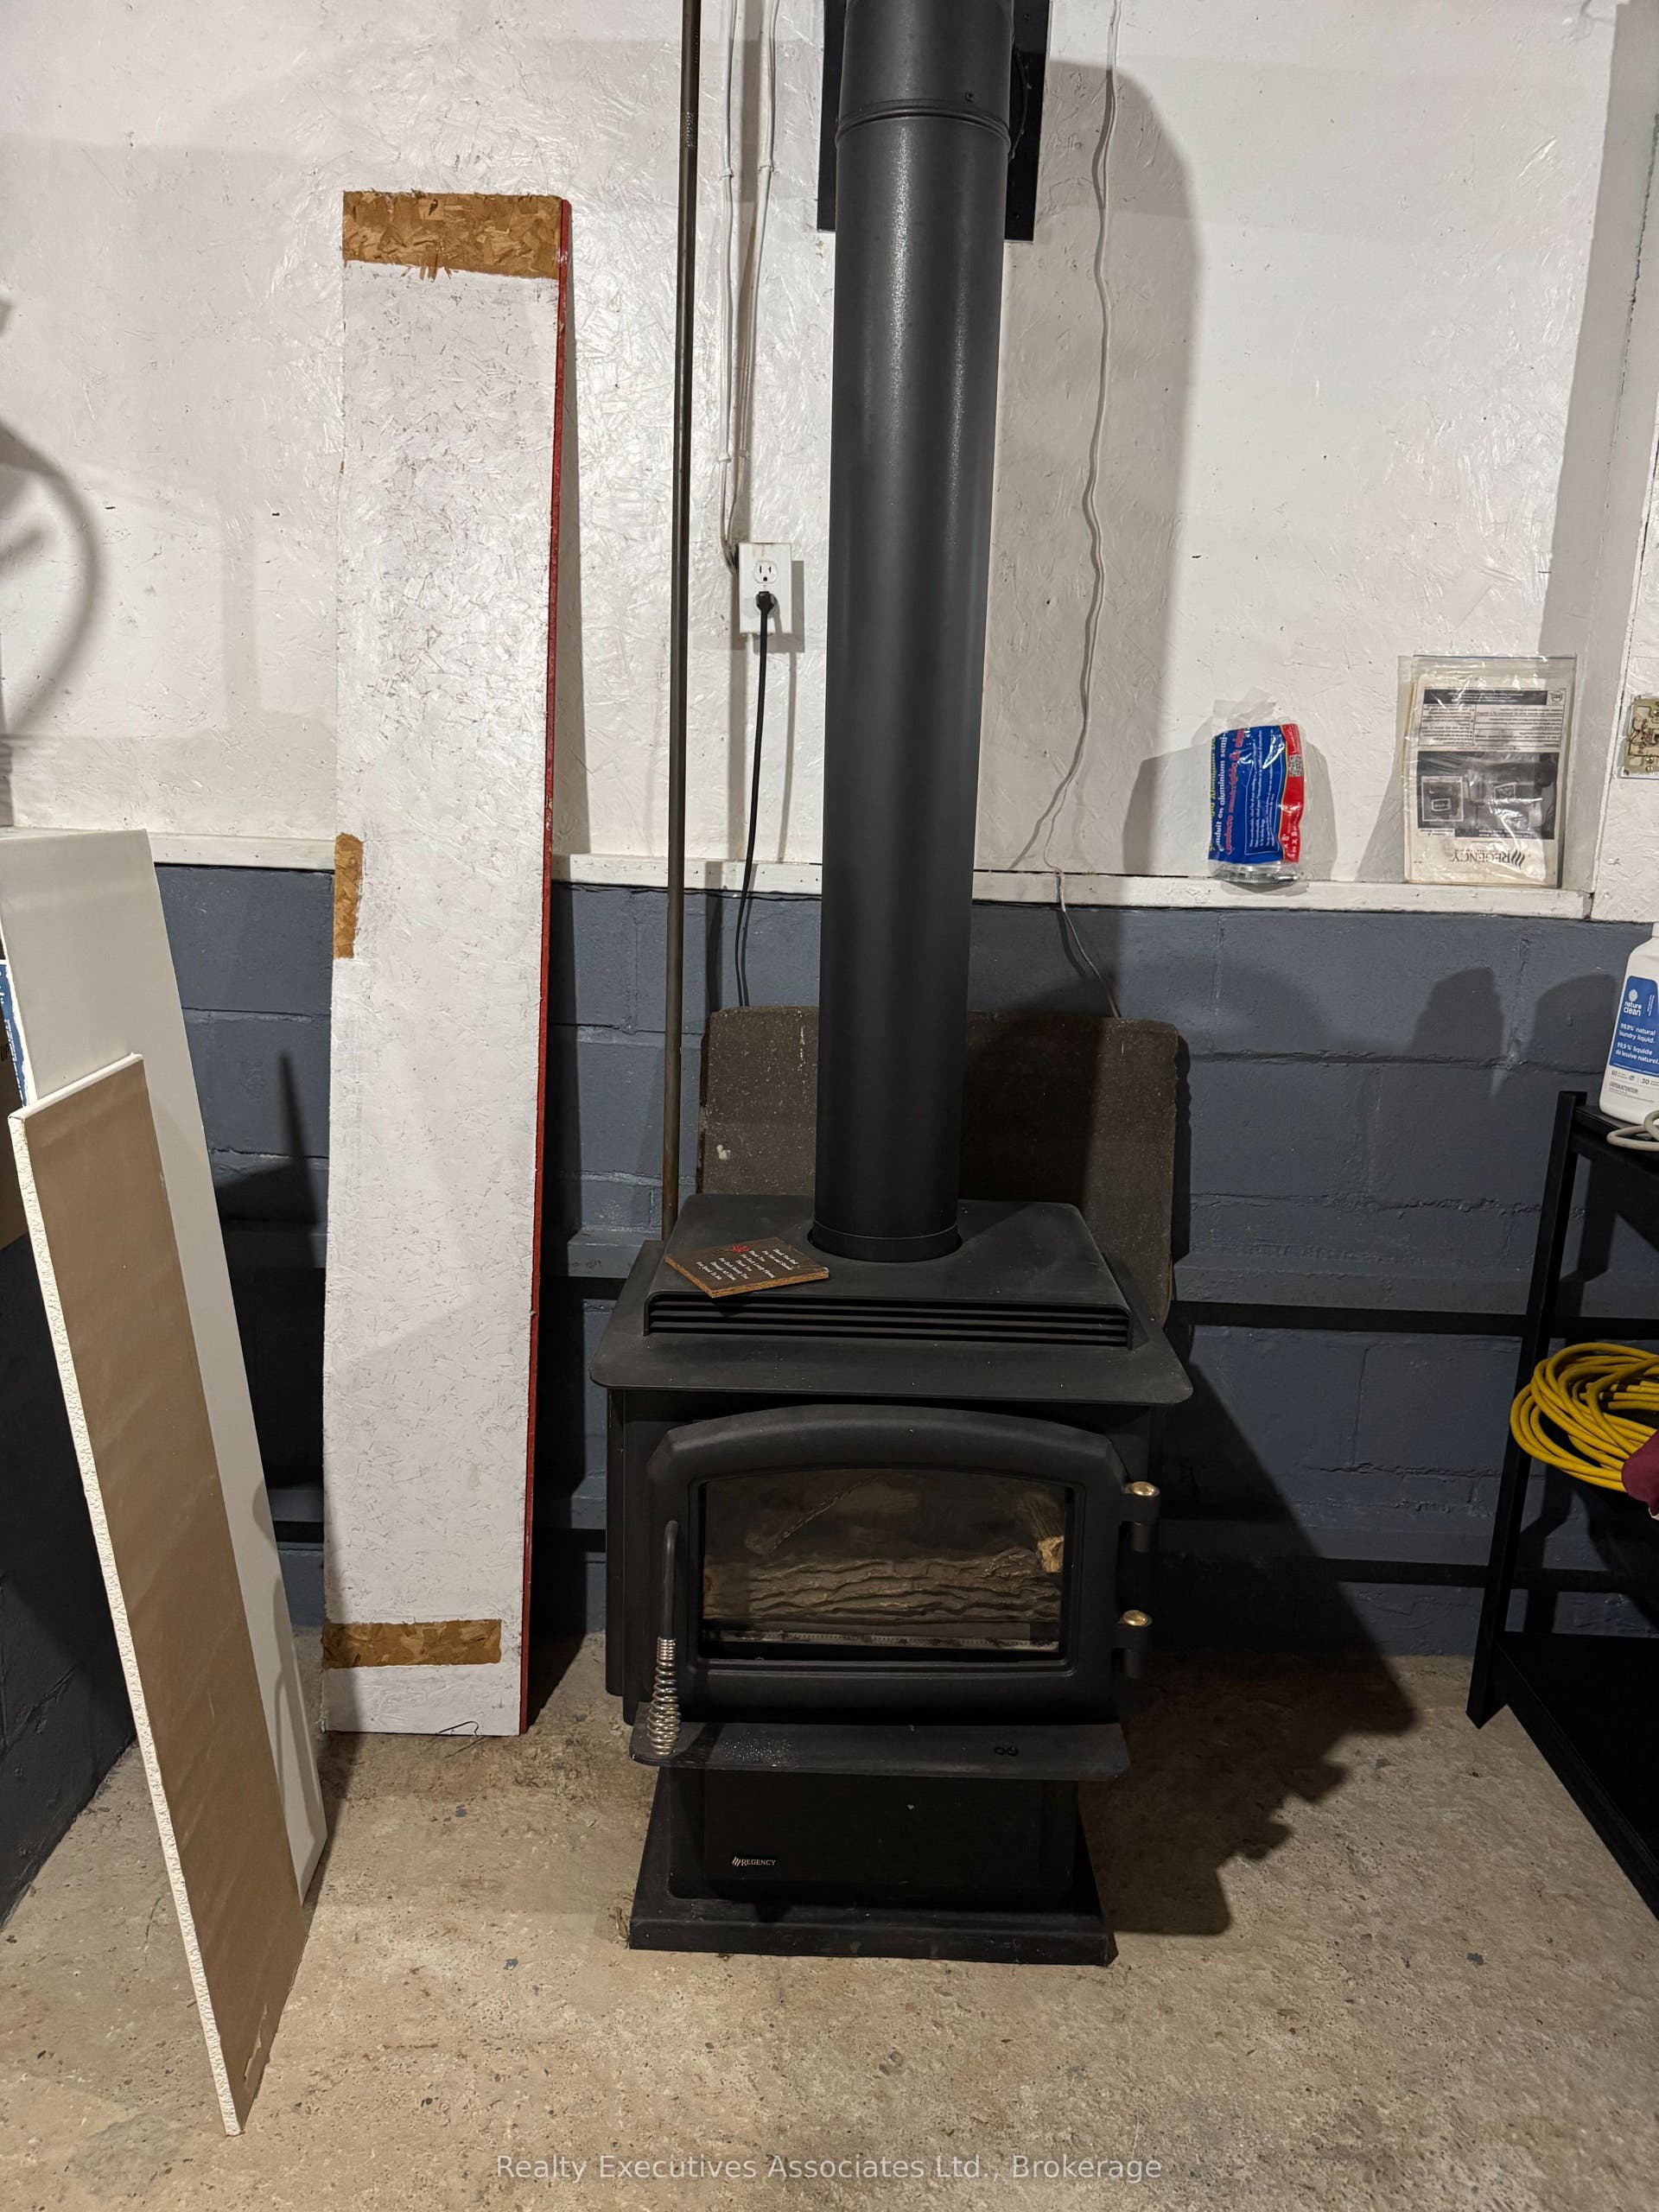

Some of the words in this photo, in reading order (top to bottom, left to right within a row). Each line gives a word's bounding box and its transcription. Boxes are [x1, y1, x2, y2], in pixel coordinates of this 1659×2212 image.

[1217, 807, 1224, 819] en
[1452, 852, 1511, 863] REGENCY
[1624, 1001, 1642, 1010] nature
[1623, 1007, 1641, 1017] clean
[1635, 1027, 1656, 1036] natural
